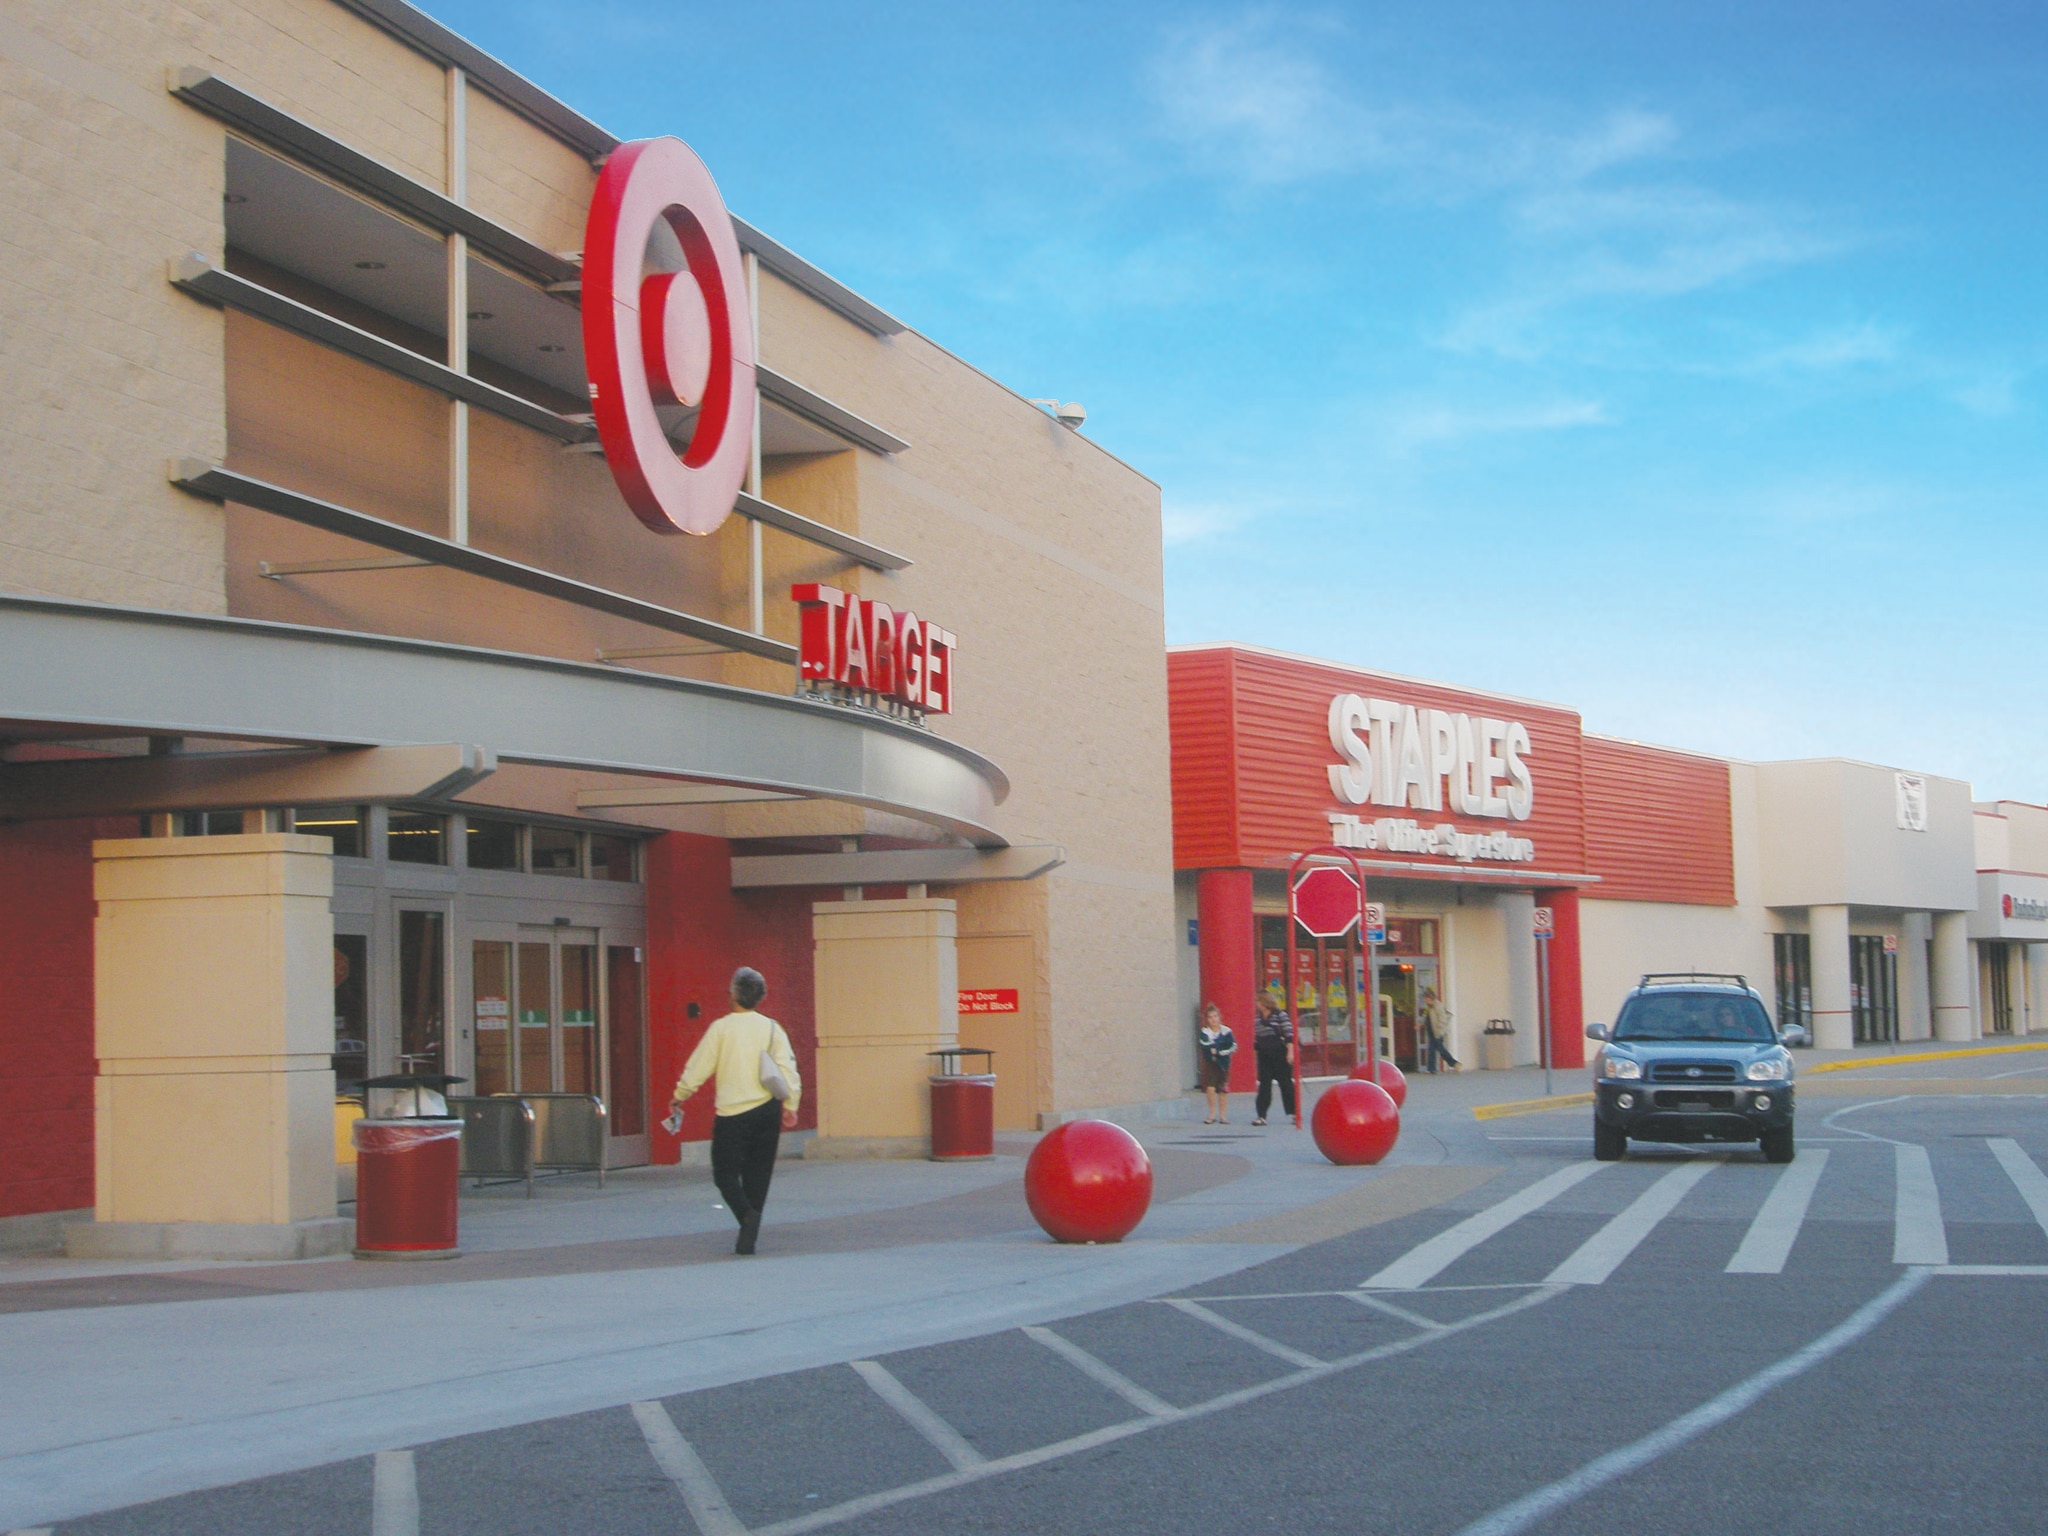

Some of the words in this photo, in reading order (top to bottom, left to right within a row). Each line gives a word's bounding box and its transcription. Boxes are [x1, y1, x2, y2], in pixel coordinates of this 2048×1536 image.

[792, 583, 957, 715] TARGET
[1327, 693, 1533, 821] STAPLES
[1329, 814, 1377, 849] The
[1375, 817, 1439, 854] Office
[1434, 824, 1534, 862] Superstore
[958, 992, 973, 1001] Fire
[976, 992, 998, 1001] Door
[958, 1002, 970, 1011] Do
[972, 1002, 988, 1011] Not
[990, 1001, 1015, 1010] Block
